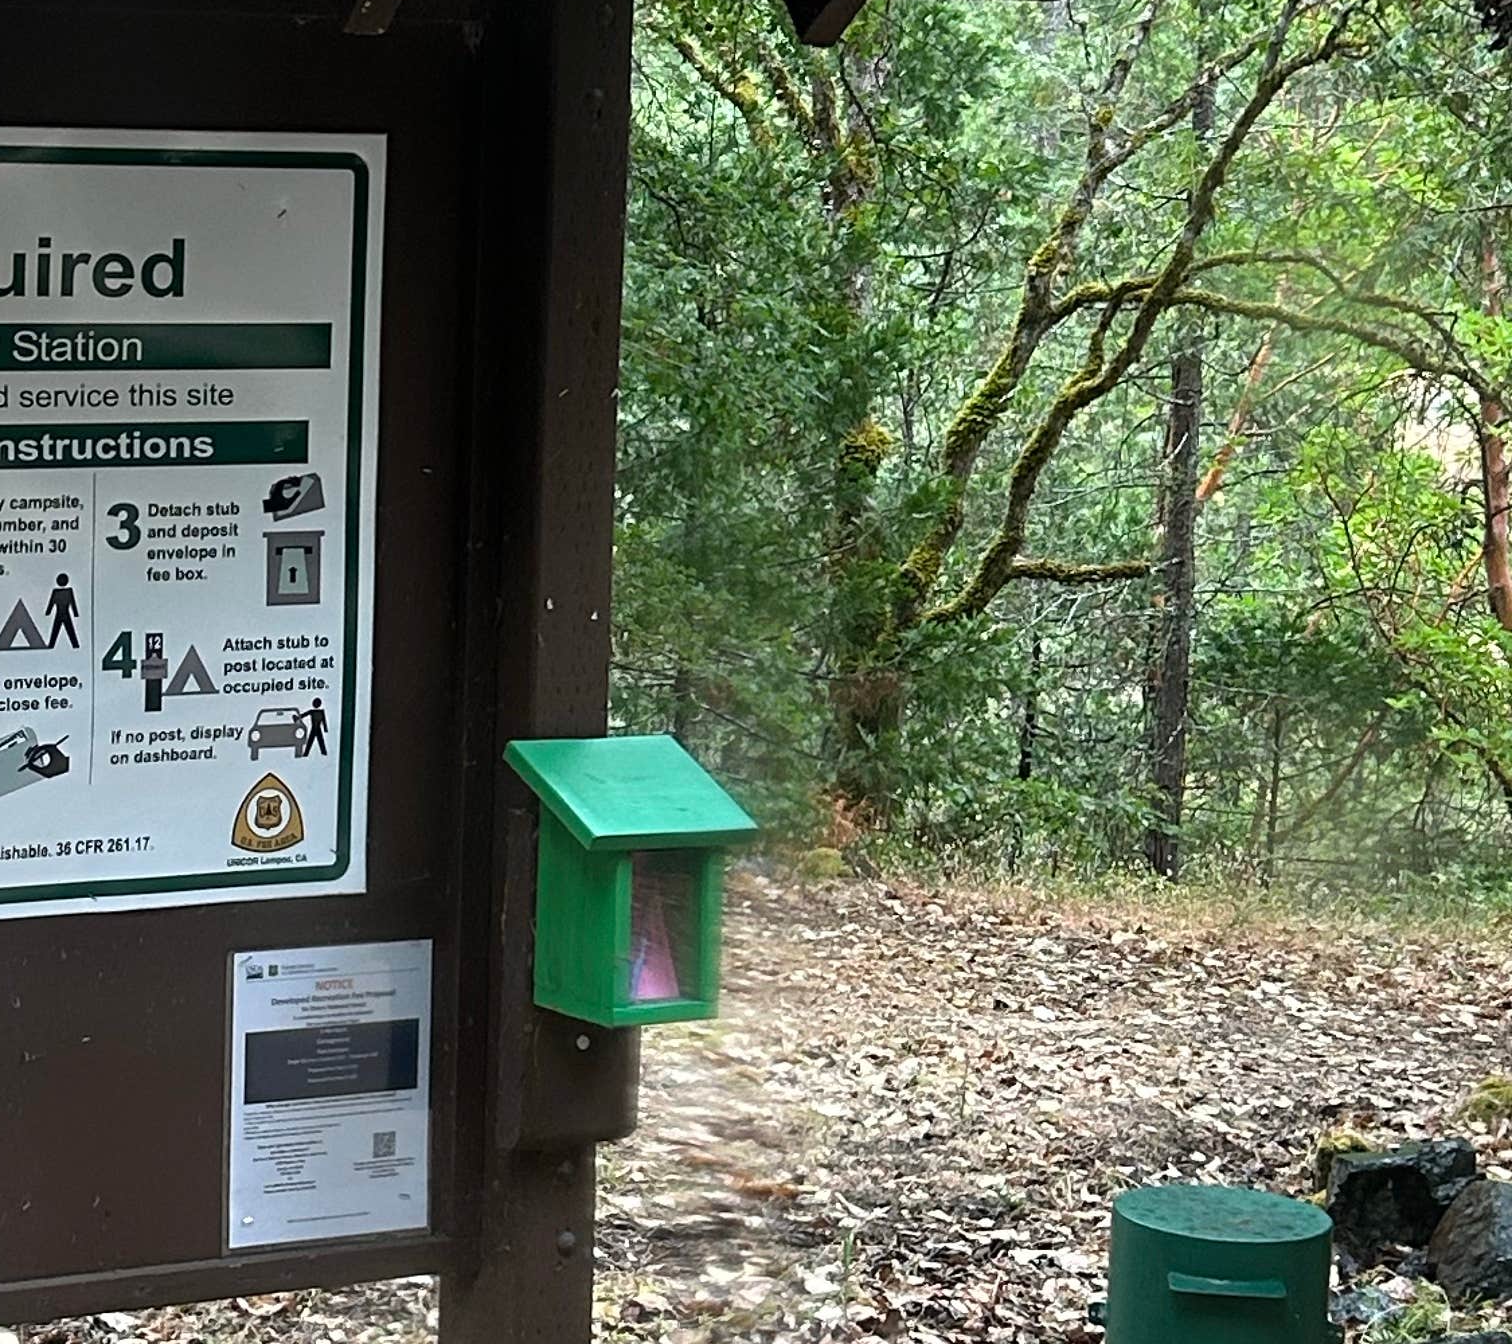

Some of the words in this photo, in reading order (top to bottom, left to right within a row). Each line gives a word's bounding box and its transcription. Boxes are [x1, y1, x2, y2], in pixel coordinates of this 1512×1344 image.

[13, 330, 142, 362] Station
[20, 387, 119, 407] service
[129, 384, 177, 407] this
[187, 384, 234, 406] site
[10, 495, 84, 513] campsite,
[149, 502, 205, 518] Detach
[209, 502, 240, 516] stub
[50, 516, 79, 531] and
[106, 503, 141, 550] 3
[147, 524, 177, 539] and
[181, 523, 238, 540] deposit
[49, 539, 66, 553] 30
[147, 545, 217, 562] envelope
[222, 544, 236, 559] in
[146, 567, 171, 582] fee
[175, 567, 208, 581] box.
[147, 636, 162, 650] 12
[223, 637, 273, 651] Attach
[277, 636, 309, 650] stub
[314, 636, 329, 648] to
[102, 632, 137, 678] 4
[223, 660, 257, 675] post
[262, 657, 316, 672] located
[321, 657, 334, 669] at
[4, 675, 83, 693] envelope,
[223, 678, 294, 697] occupied
[299, 678, 330, 691] site.
[44, 697, 73, 711] fee.
[111, 730, 121, 744] If
[125, 731, 144, 744] no
[149, 729, 185, 748] post,
[191, 724, 243, 744] display
[111, 751, 130, 765] on
[134, 748, 217, 763] dashboard.
[57, 843, 71, 856] 36
[75, 840, 103, 855] CFR
[315, 978, 354, 991] NOTICE
